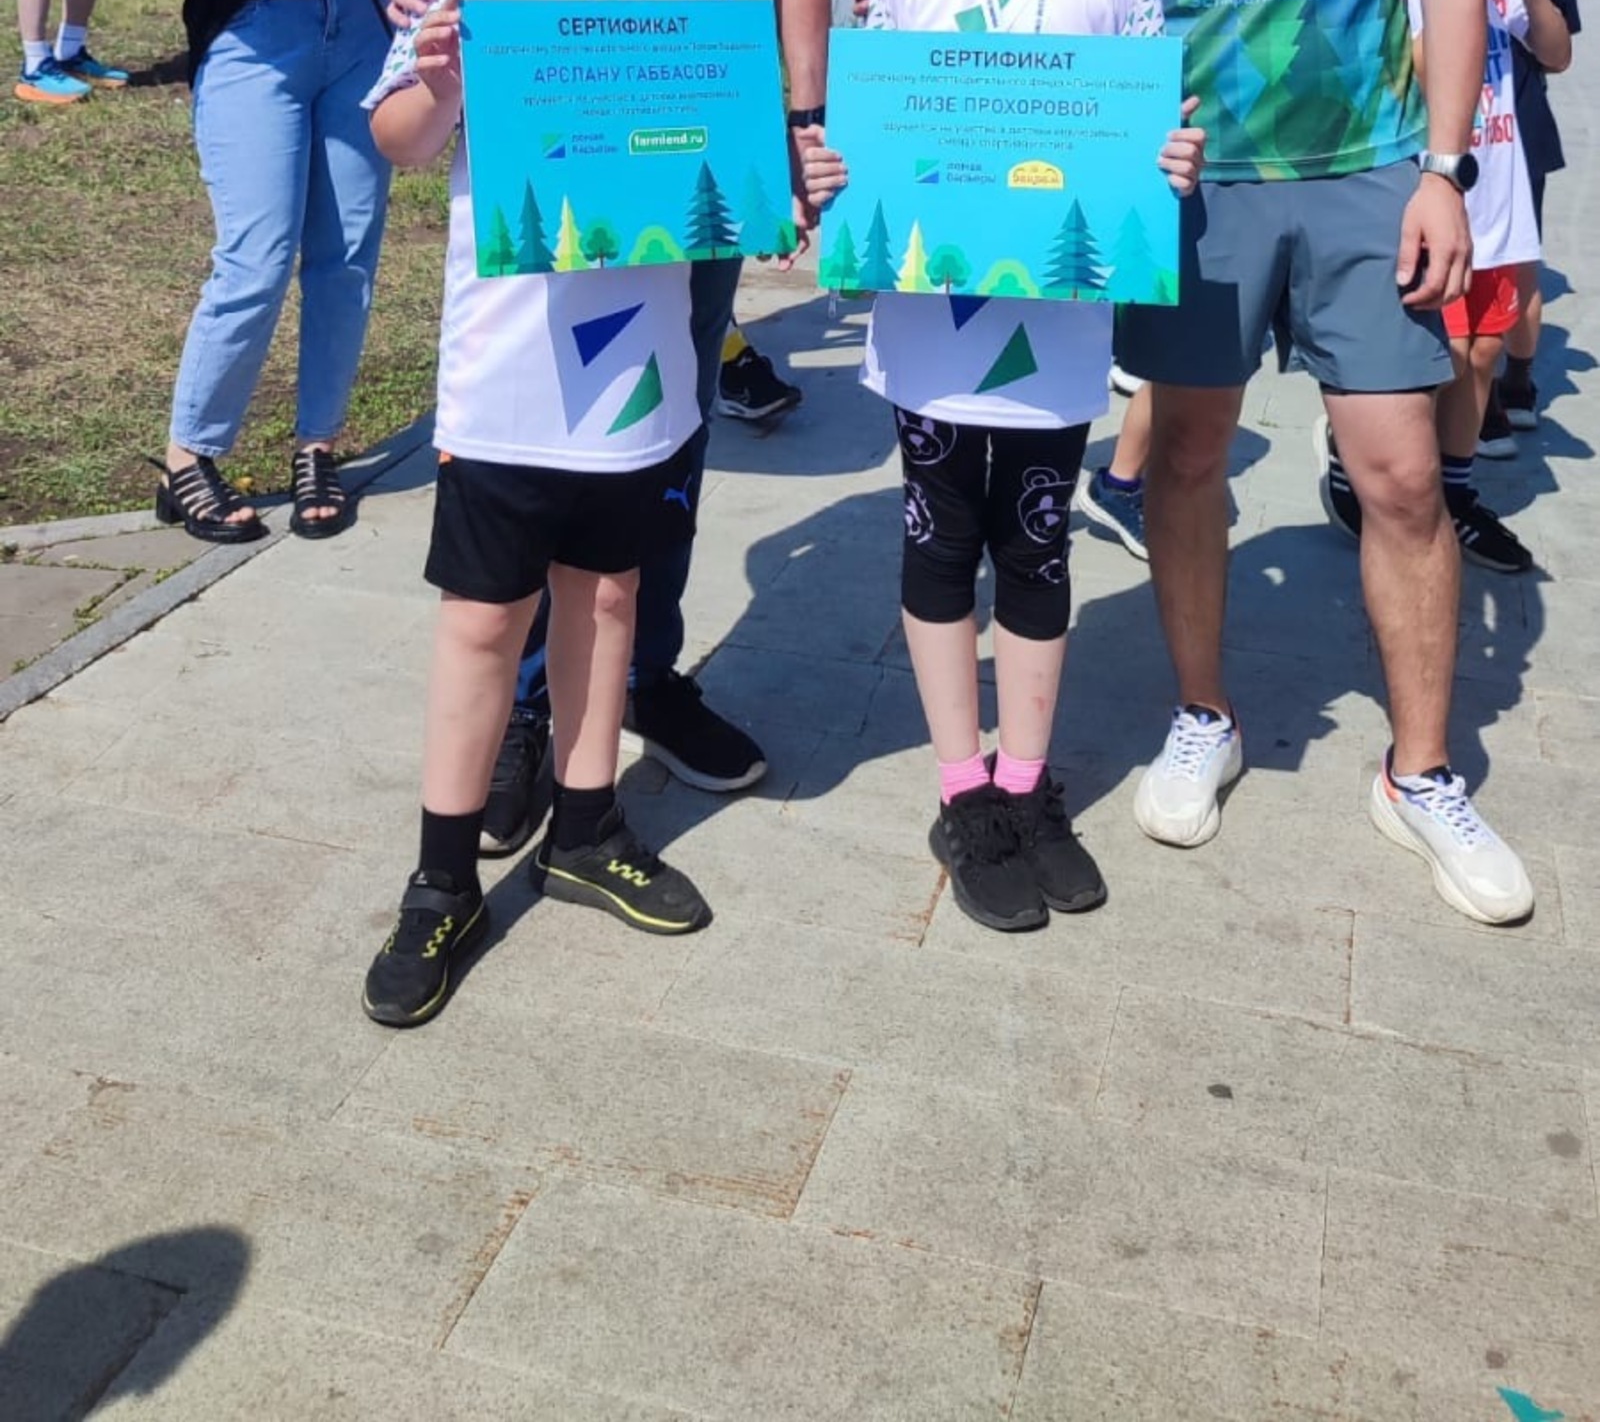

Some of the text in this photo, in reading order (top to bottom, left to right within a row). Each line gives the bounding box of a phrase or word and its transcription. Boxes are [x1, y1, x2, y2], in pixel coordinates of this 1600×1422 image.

[558, 17, 688, 36] СЕРТИФИКАТ
[930, 49, 1075, 70] СЕРТИФИКАТ
[534, 63, 728, 83] АРСЛАНУ ГАББАСОВУ
[904, 95, 1098, 116] ЛИЗЕ ПРОХОРОВОЙ
